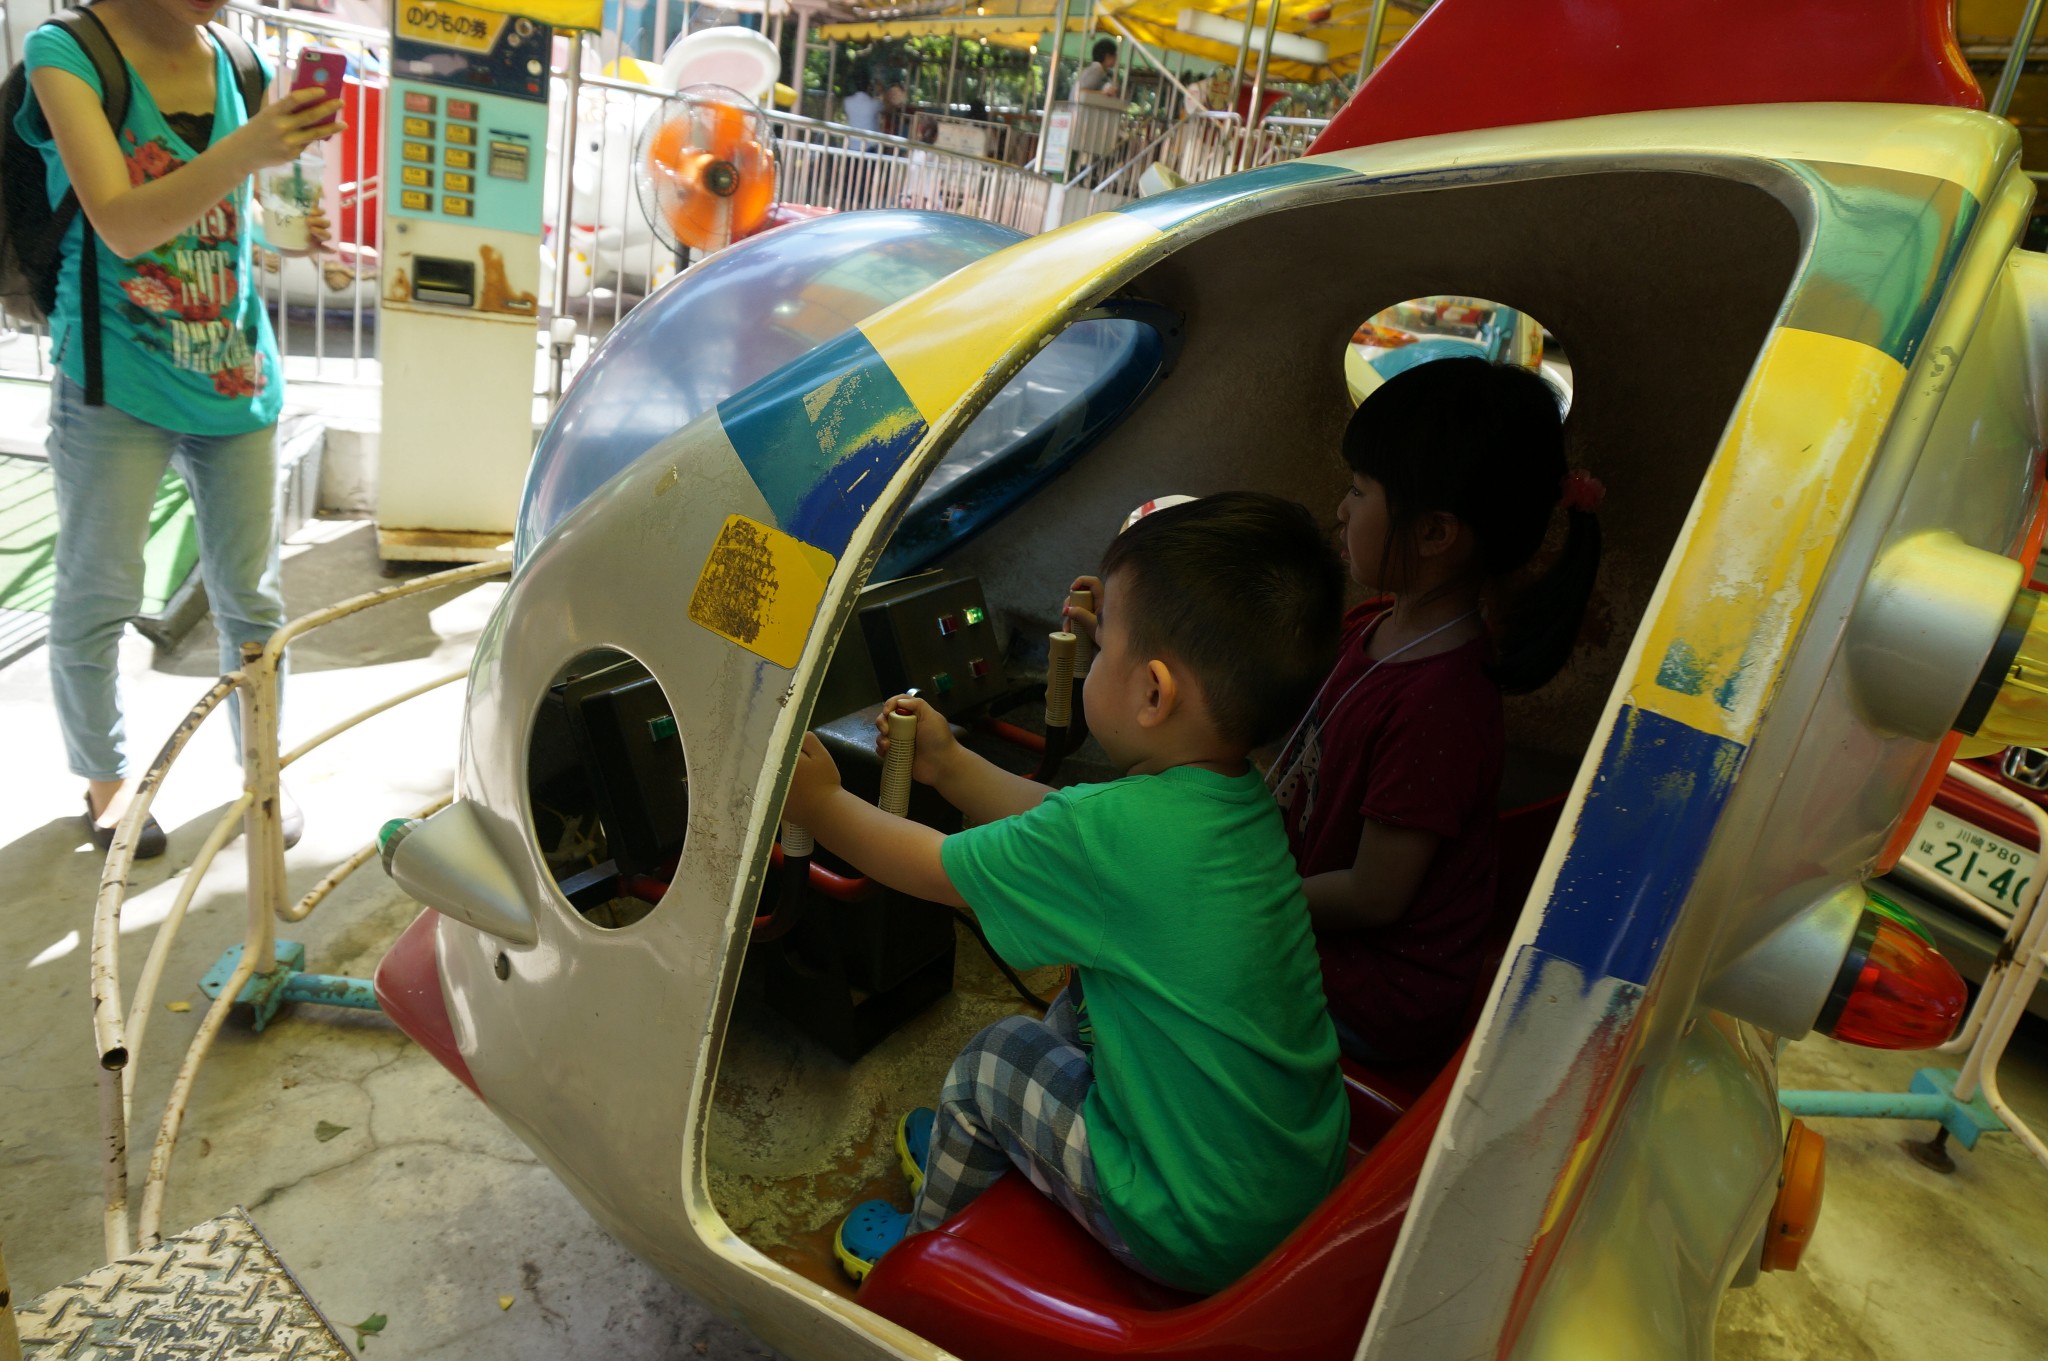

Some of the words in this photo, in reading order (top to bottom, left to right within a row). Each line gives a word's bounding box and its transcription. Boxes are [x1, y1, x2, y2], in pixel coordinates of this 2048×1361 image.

[406, 6, 487, 39] のりもの券
[175, 249, 229, 306] NOT
[1921, 840, 1934, 855] ほ
[1986, 842, 2020, 865] 980
